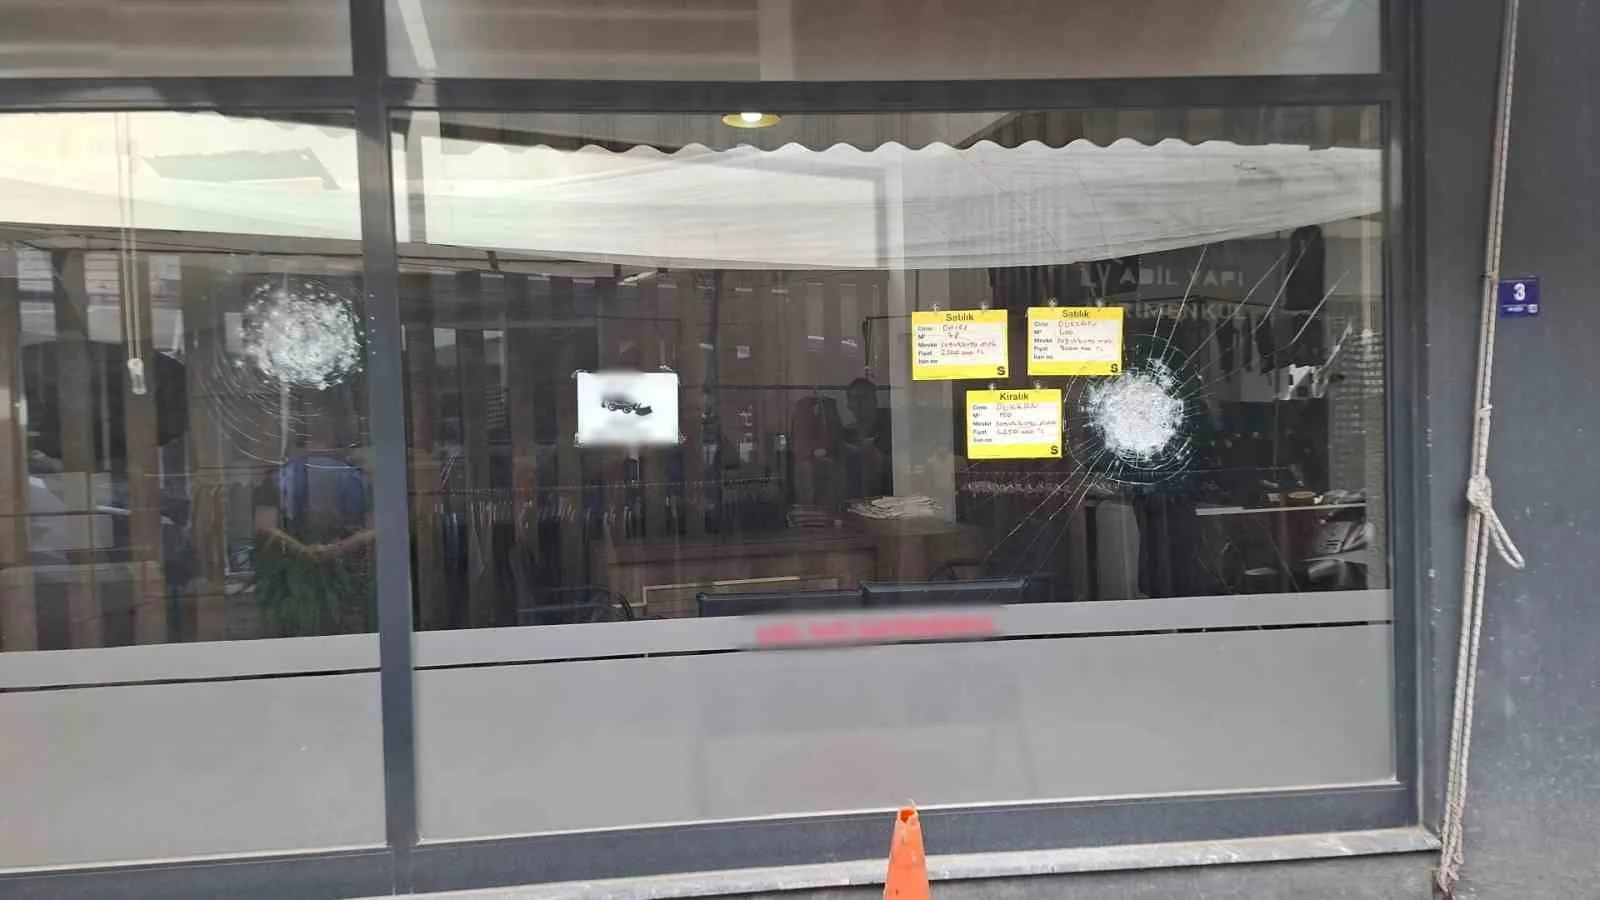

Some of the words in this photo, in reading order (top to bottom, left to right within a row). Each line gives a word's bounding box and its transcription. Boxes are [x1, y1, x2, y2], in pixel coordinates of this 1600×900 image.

[1514, 283, 1525, 301] 3
[945, 313, 974, 321] Satılık
[1062, 310, 1089, 318] Satılık
[996, 366, 1005, 375] S
[1111, 363, 1119, 373] S
[1000, 392, 1029, 401] Kiralık
[1050, 445, 1058, 455] S
